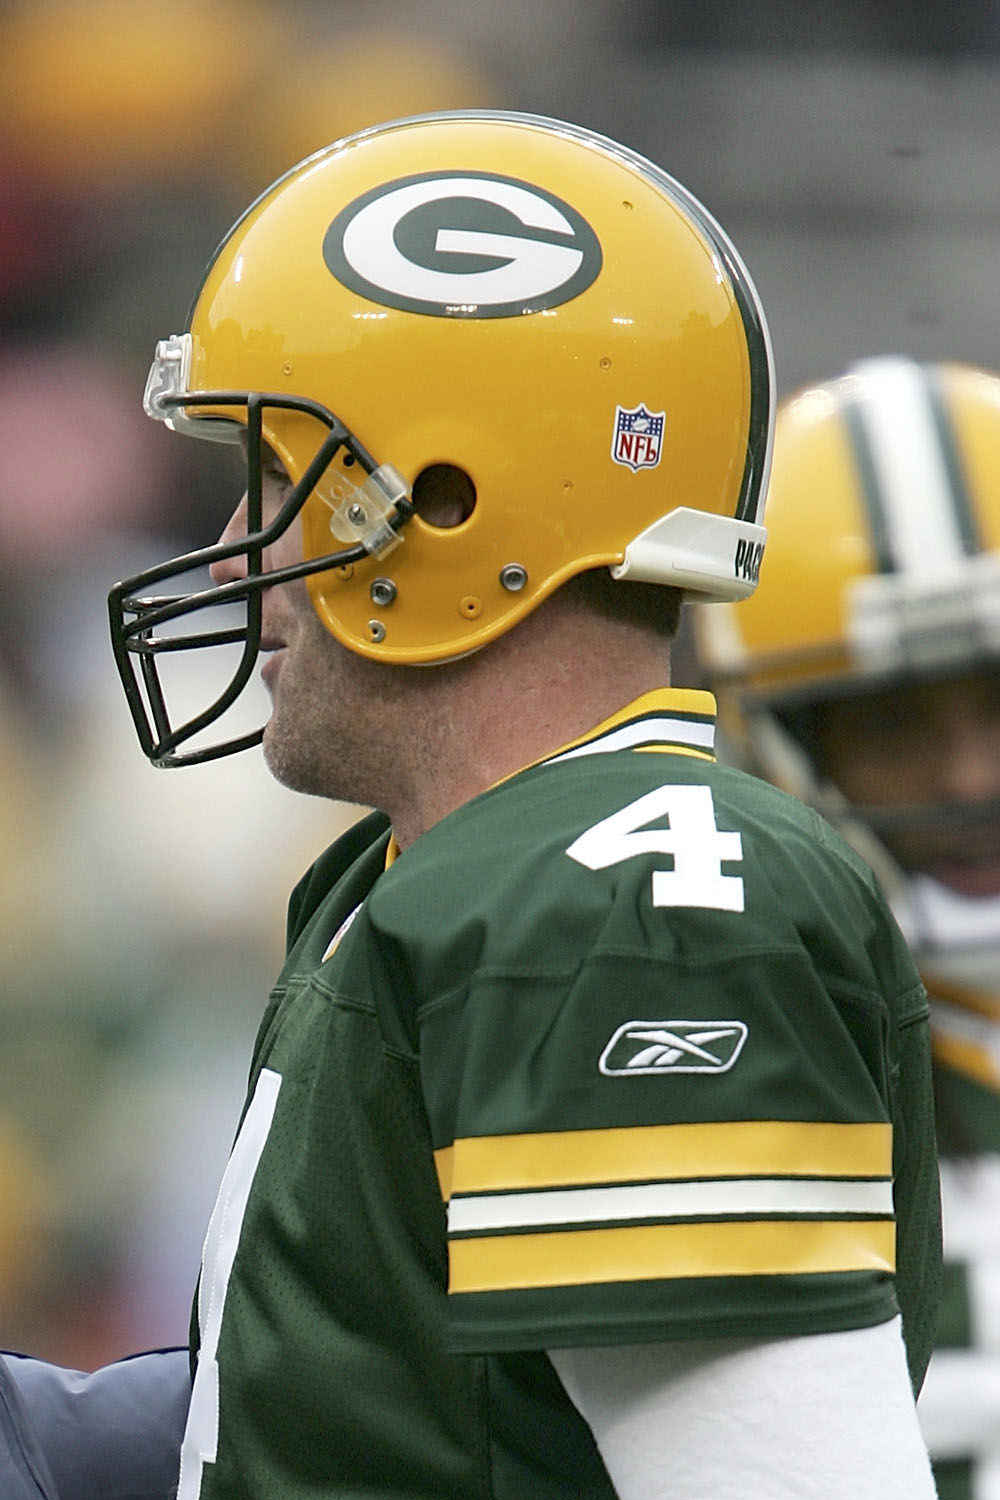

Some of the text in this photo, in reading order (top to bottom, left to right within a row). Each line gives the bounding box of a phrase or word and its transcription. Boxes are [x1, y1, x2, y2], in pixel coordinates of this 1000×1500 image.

[618, 432, 656, 464] NFL
[735, 538, 765, 582] PAC
[565, 784, 745, 913] 4
